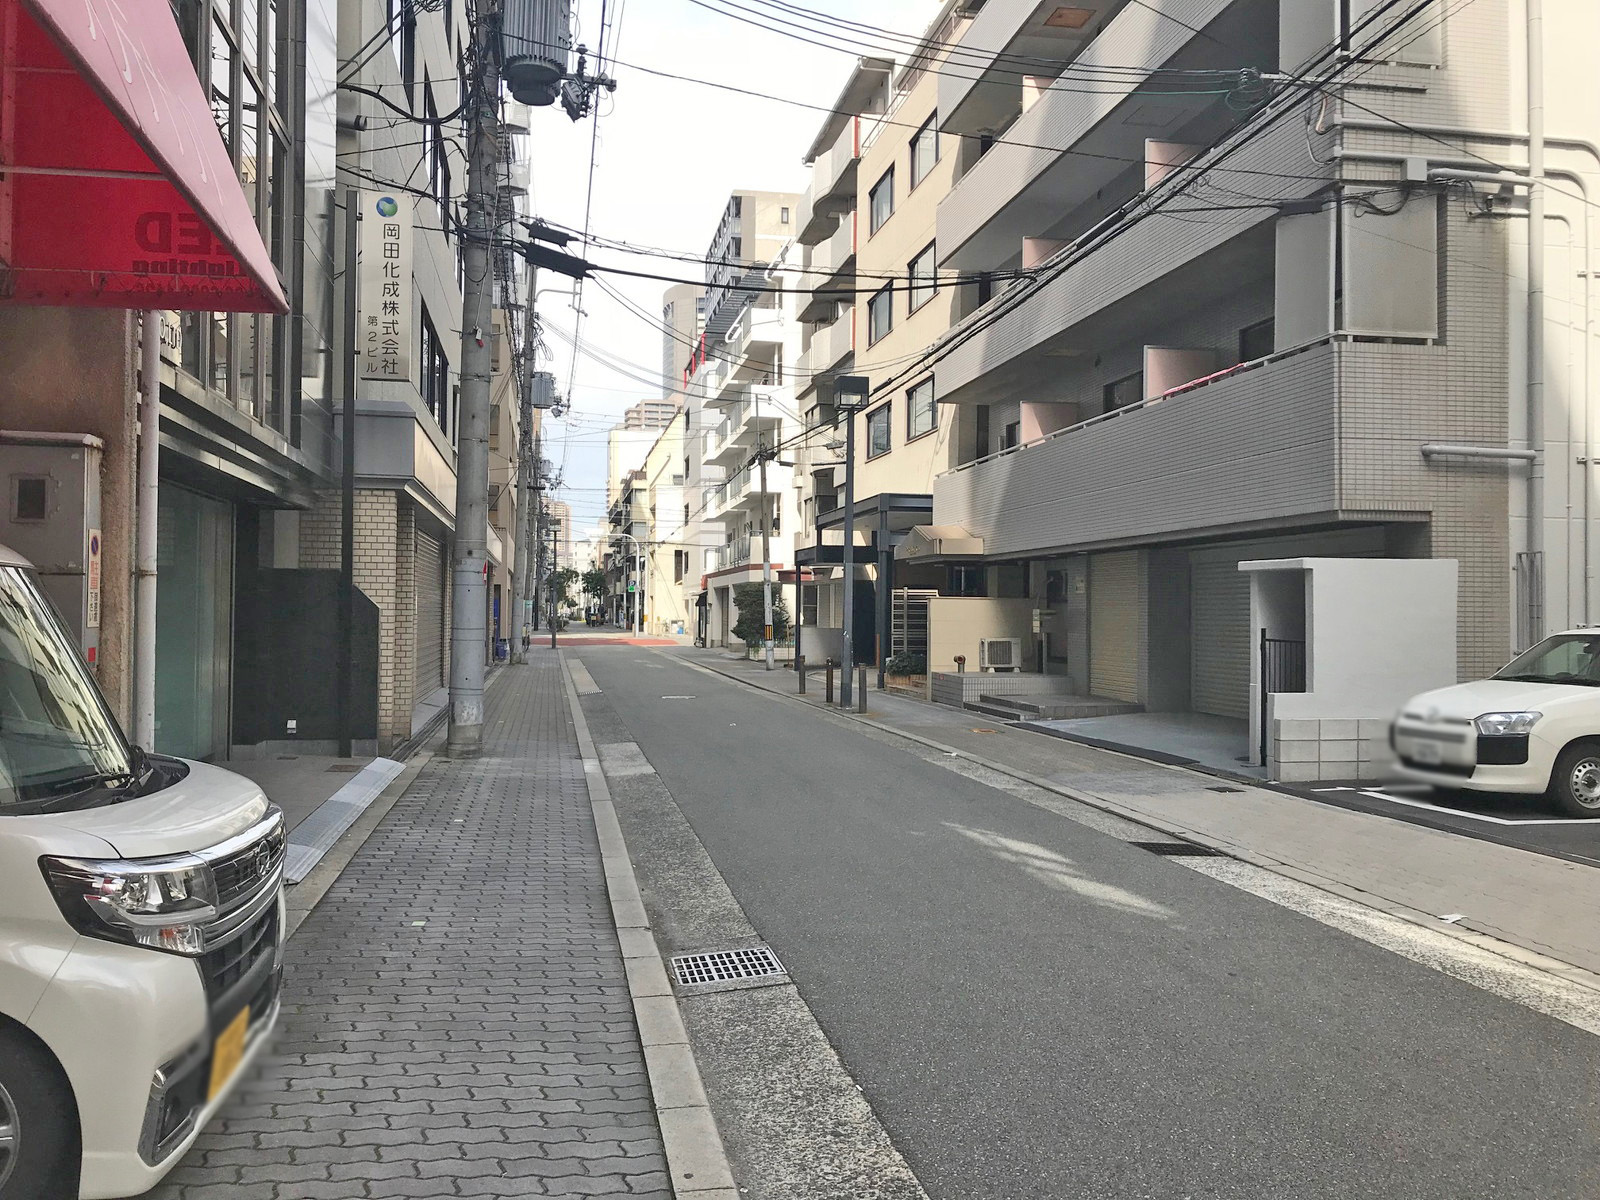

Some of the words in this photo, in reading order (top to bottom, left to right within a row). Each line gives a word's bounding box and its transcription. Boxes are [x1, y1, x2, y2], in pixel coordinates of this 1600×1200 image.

[366, 315, 378, 373] 第2ビル
[382, 223, 400, 375] 岡田化成株式会社
